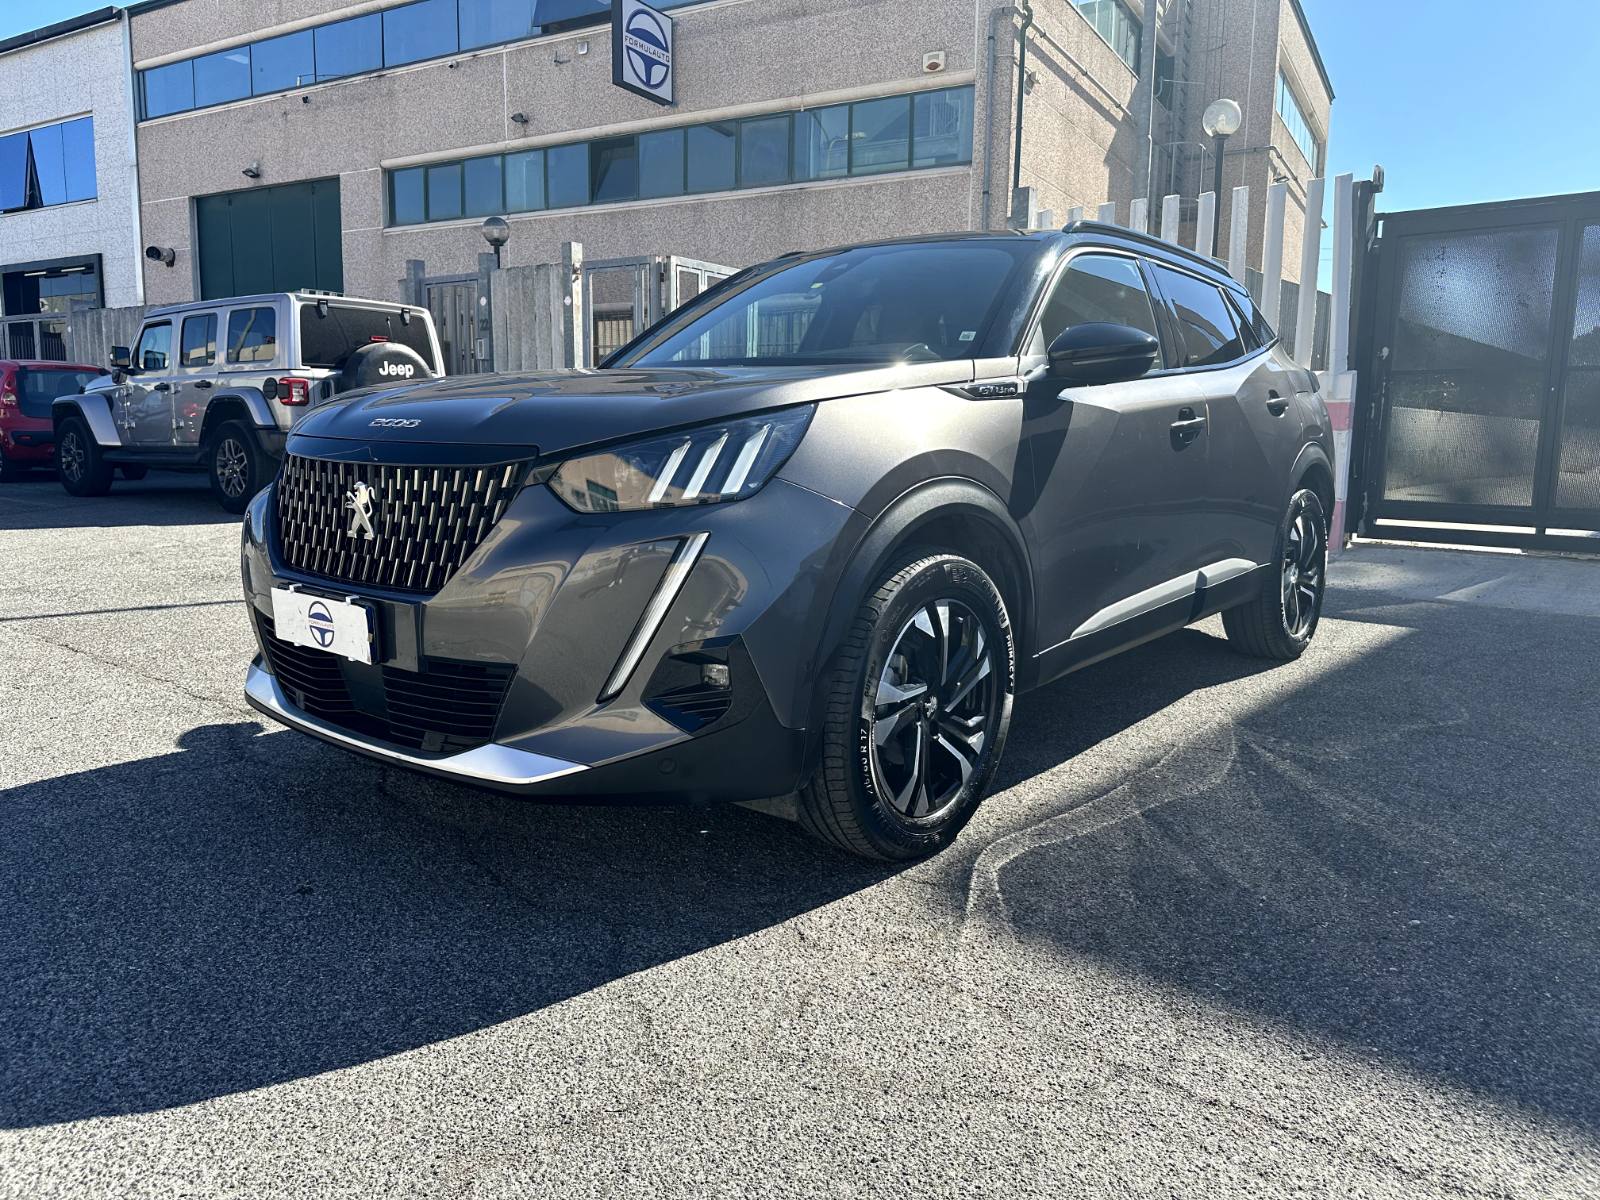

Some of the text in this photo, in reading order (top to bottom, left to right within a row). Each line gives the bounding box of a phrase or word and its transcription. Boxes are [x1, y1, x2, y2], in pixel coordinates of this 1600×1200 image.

[624, 35, 670, 62] FORMULAUTO
[379, 361, 414, 378] Jeep
[368, 418, 421, 427] 2008
[1005, 634, 1014, 680] PRIMACY
